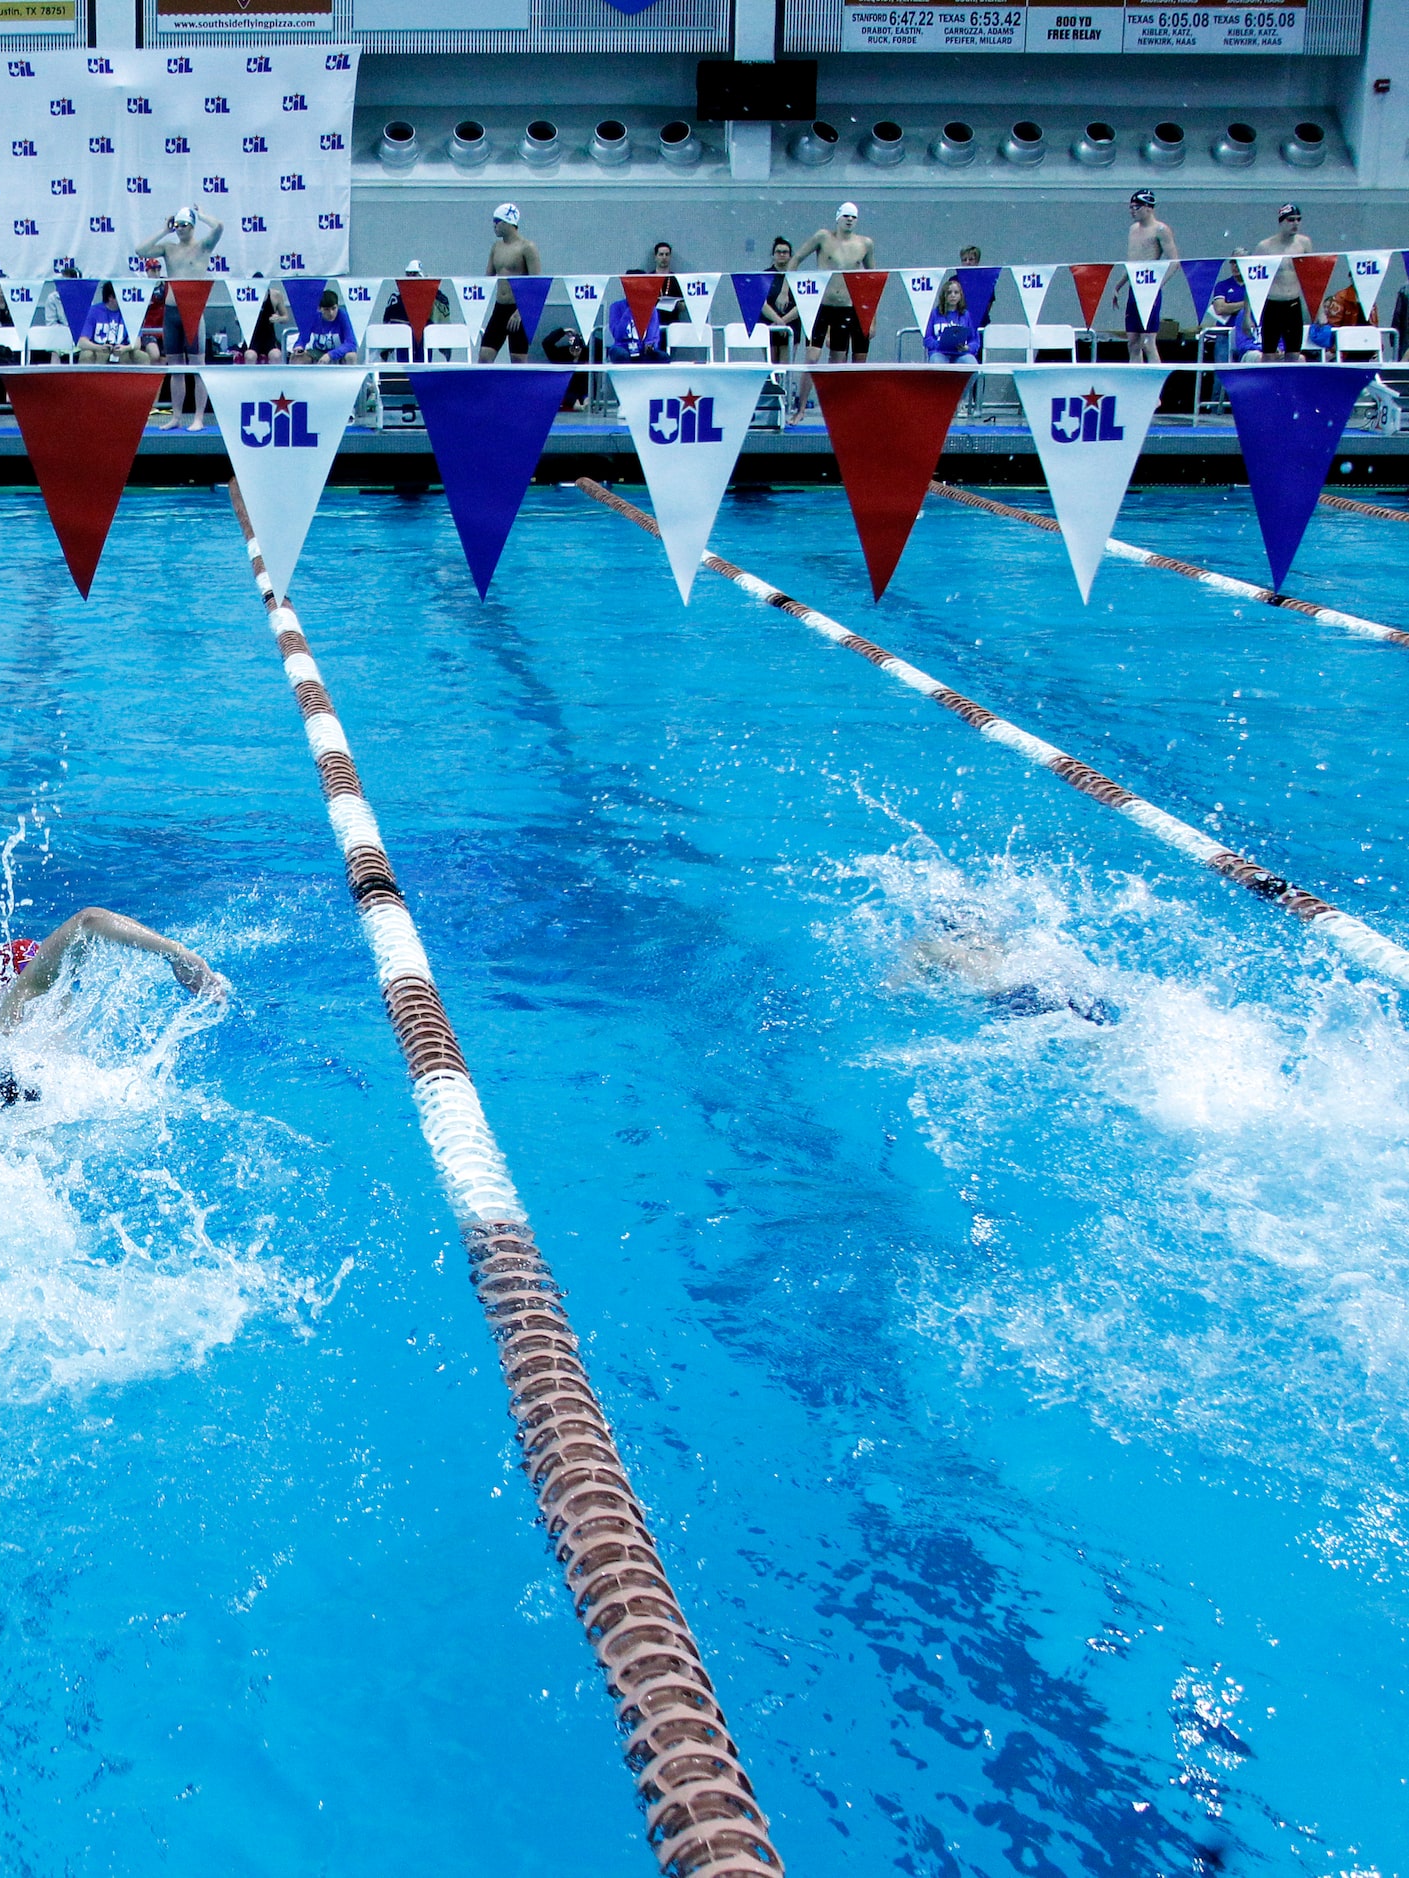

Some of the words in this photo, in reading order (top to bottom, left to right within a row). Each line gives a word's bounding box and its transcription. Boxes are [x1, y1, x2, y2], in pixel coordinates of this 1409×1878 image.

[26, 6, 37, 16] TX
[40, 6, 66, 16] 78751
[851, 13, 888, 23] STANFORD
[889, 11, 934, 26] 6:47.22
[938, 13, 966, 23] TEXAS
[969, 11, 1022, 27] 6:53.42
[1127, 14, 1154, 24] TEXAS
[1158, 12, 1210, 28] 6:05.08
[1213, 14, 1240, 24] TEXAS
[1244, 12, 1295, 28] 6:05.08
[173, 18, 316, 30] www.southsideflyingpizza.com
[987, 27, 1015, 35] ADAMS
[1055, 16, 1077, 28] 800
[1078, 16, 1092, 28] YD
[867, 36, 891, 44] RUCK,
[892, 36, 917, 44] FORDE
[945, 37, 978, 45] PFEIFER,
[979, 36, 1013, 45] MILLARD
[1047, 29, 1071, 40] FREE
[1072, 29, 1102, 40] RELAY
[1137, 37, 1175, 46] NEWKIRK,
[1176, 37, 1197, 46] HAAS
[1223, 37, 1261, 46] NEWKIRK,
[1261, 37, 1283, 46] HAAS
[7, 59, 36, 78] UIL
[87, 56, 114, 74] UIL
[167, 55, 194, 74] UIL
[246, 54, 273, 74] UIL
[325, 52, 351, 71] UIL
[50, 97, 76, 117] UIL
[127, 95, 153, 115] UIL
[204, 95, 231, 114] UIL
[282, 93, 308, 112] UIL
[12, 138, 38, 157] UIL
[89, 135, 115, 154] UIL
[165, 135, 191, 154] UIL
[242, 134, 269, 154] UIL
[319, 132, 345, 151] UIL
[51, 177, 77, 196] UIL
[127, 175, 152, 194] UIL
[203, 175, 229, 194] UIL
[280, 173, 306, 192] UIL
[13, 218, 40, 236] UIL
[89, 215, 115, 233] UIL
[241, 215, 267, 233] UIL
[318, 211, 344, 230] UIL
[280, 252, 306, 271] UIL
[1356, 259, 1380, 276] UIL
[1023, 273, 1043, 289] UIL
[1135, 269, 1157, 285] UIL
[1248, 264, 1269, 280] UIL
[463, 284, 486, 301] UIL
[574, 284, 598, 300] UIL
[687, 280, 709, 297] UIL
[797, 278, 819, 295] UIL
[911, 275, 933, 292] UIL
[10, 286, 33, 302] UIL
[122, 286, 145, 303] UIL
[236, 286, 259, 302] UIL
[348, 285, 371, 302] UIL
[240, 392, 320, 448] UIL
[402, 404, 416, 423] 5
[648, 387, 725, 445] UIL
[1050, 386, 1125, 444] UIL
[1381, 405, 1389, 425] 8
